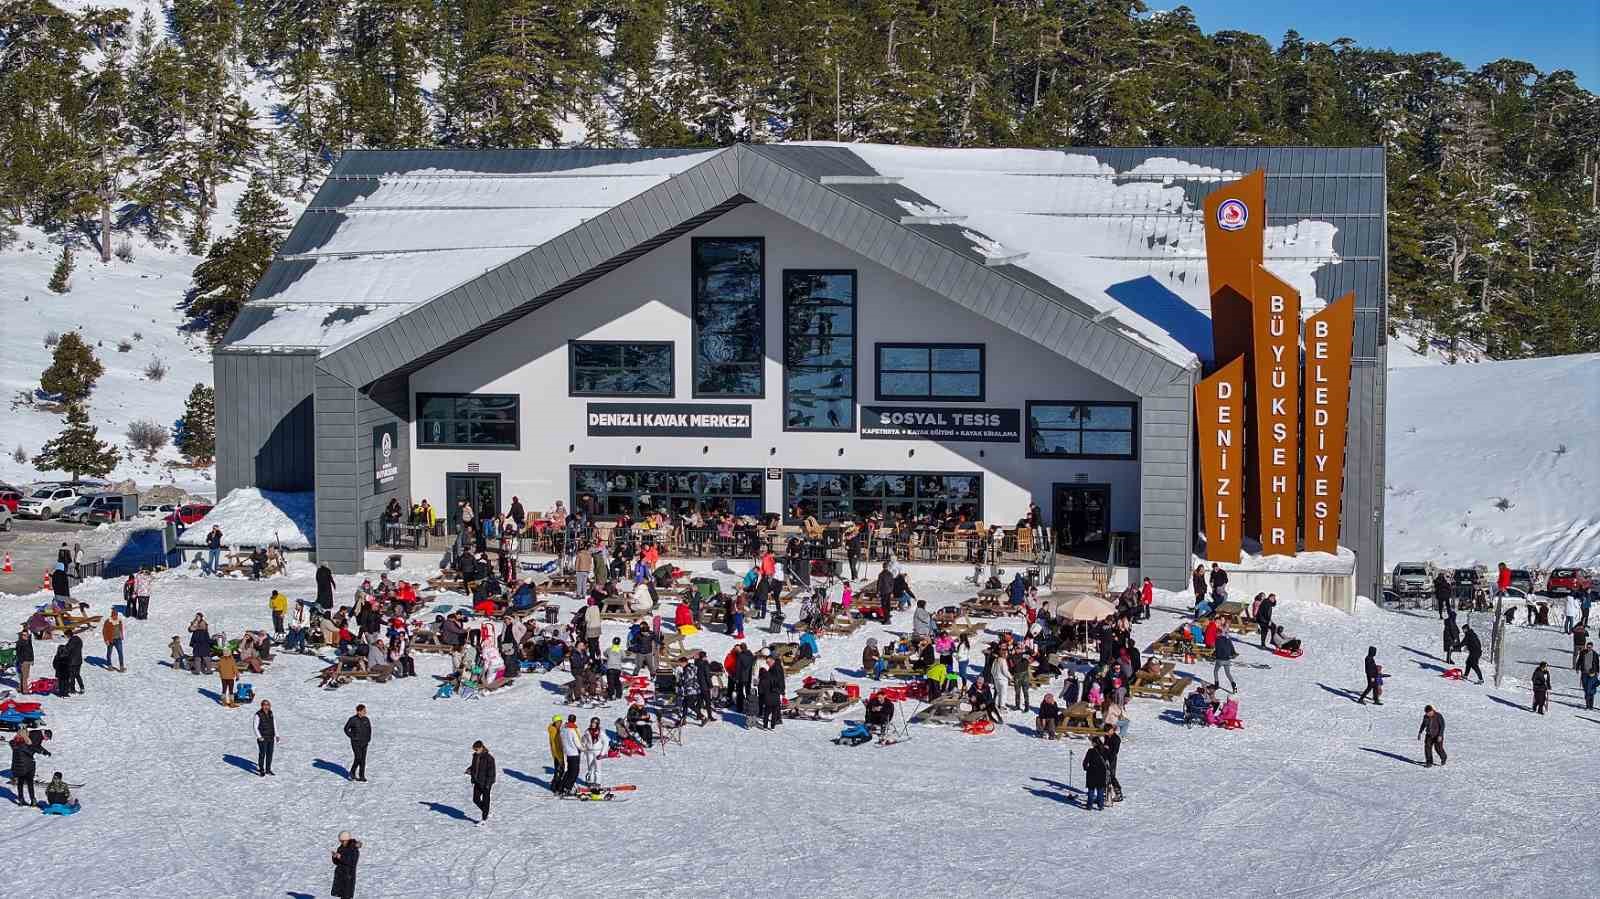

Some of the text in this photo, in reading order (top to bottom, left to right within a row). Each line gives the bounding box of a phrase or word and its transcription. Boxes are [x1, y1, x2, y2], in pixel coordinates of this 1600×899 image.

[643, 414, 688, 427] KAYAK
[880, 412, 1001, 426] SOSYAL TESİS
[1217, 382, 1232, 541] DENİZLİ
[1270, 295, 1286, 545] BÜYÜKŞEHİR
[1314, 321, 1328, 542] BELEDİYESİ
